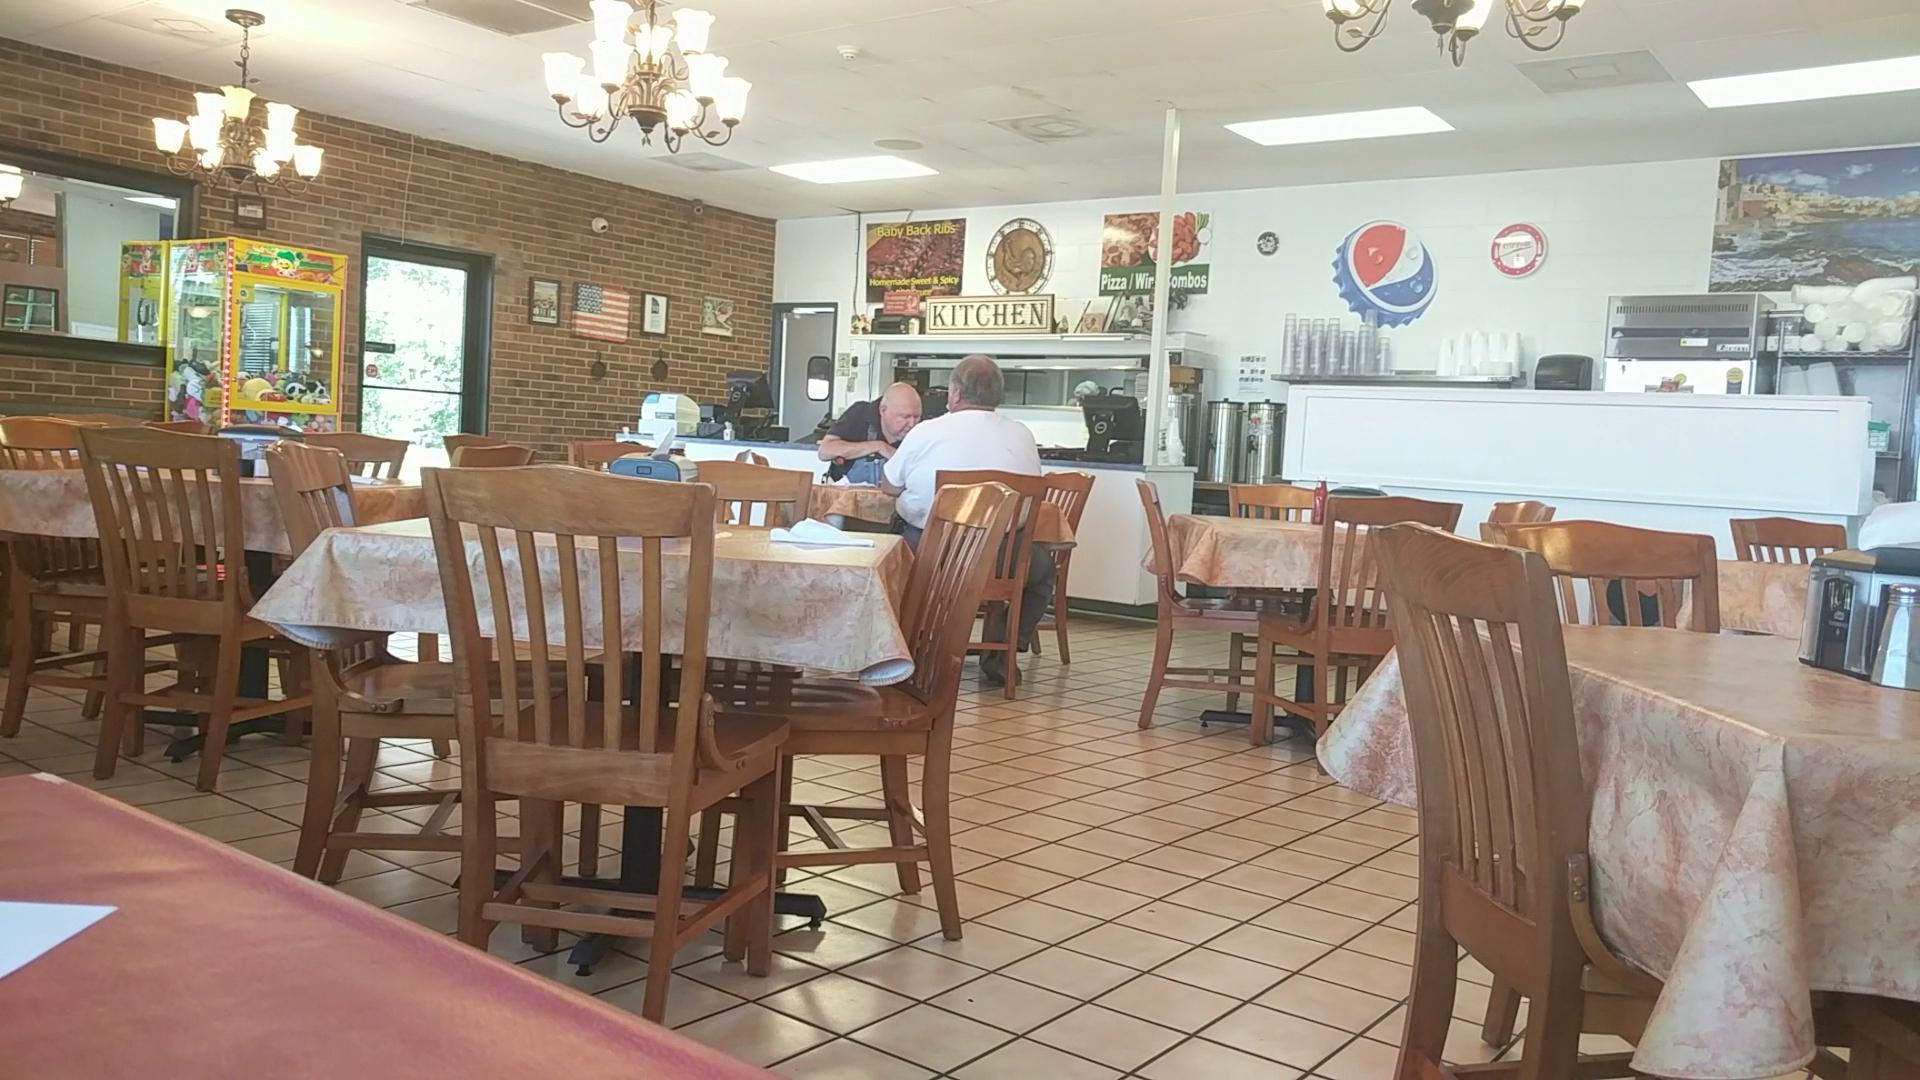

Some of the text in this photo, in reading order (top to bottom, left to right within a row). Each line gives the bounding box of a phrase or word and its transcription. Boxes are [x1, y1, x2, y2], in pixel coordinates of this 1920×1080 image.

[877, 222, 956, 239] Baby Back Ribs
[869, 278, 909, 287] Homemade
[910, 276, 932, 286] Sweet
[940, 275, 960, 286] Spicy
[1100, 273, 1127, 291] Pizza
[1128, 272, 1134, 290] /
[1169, 271, 1207, 289] ombos
[932, 303, 1045, 327] KITCHEN
